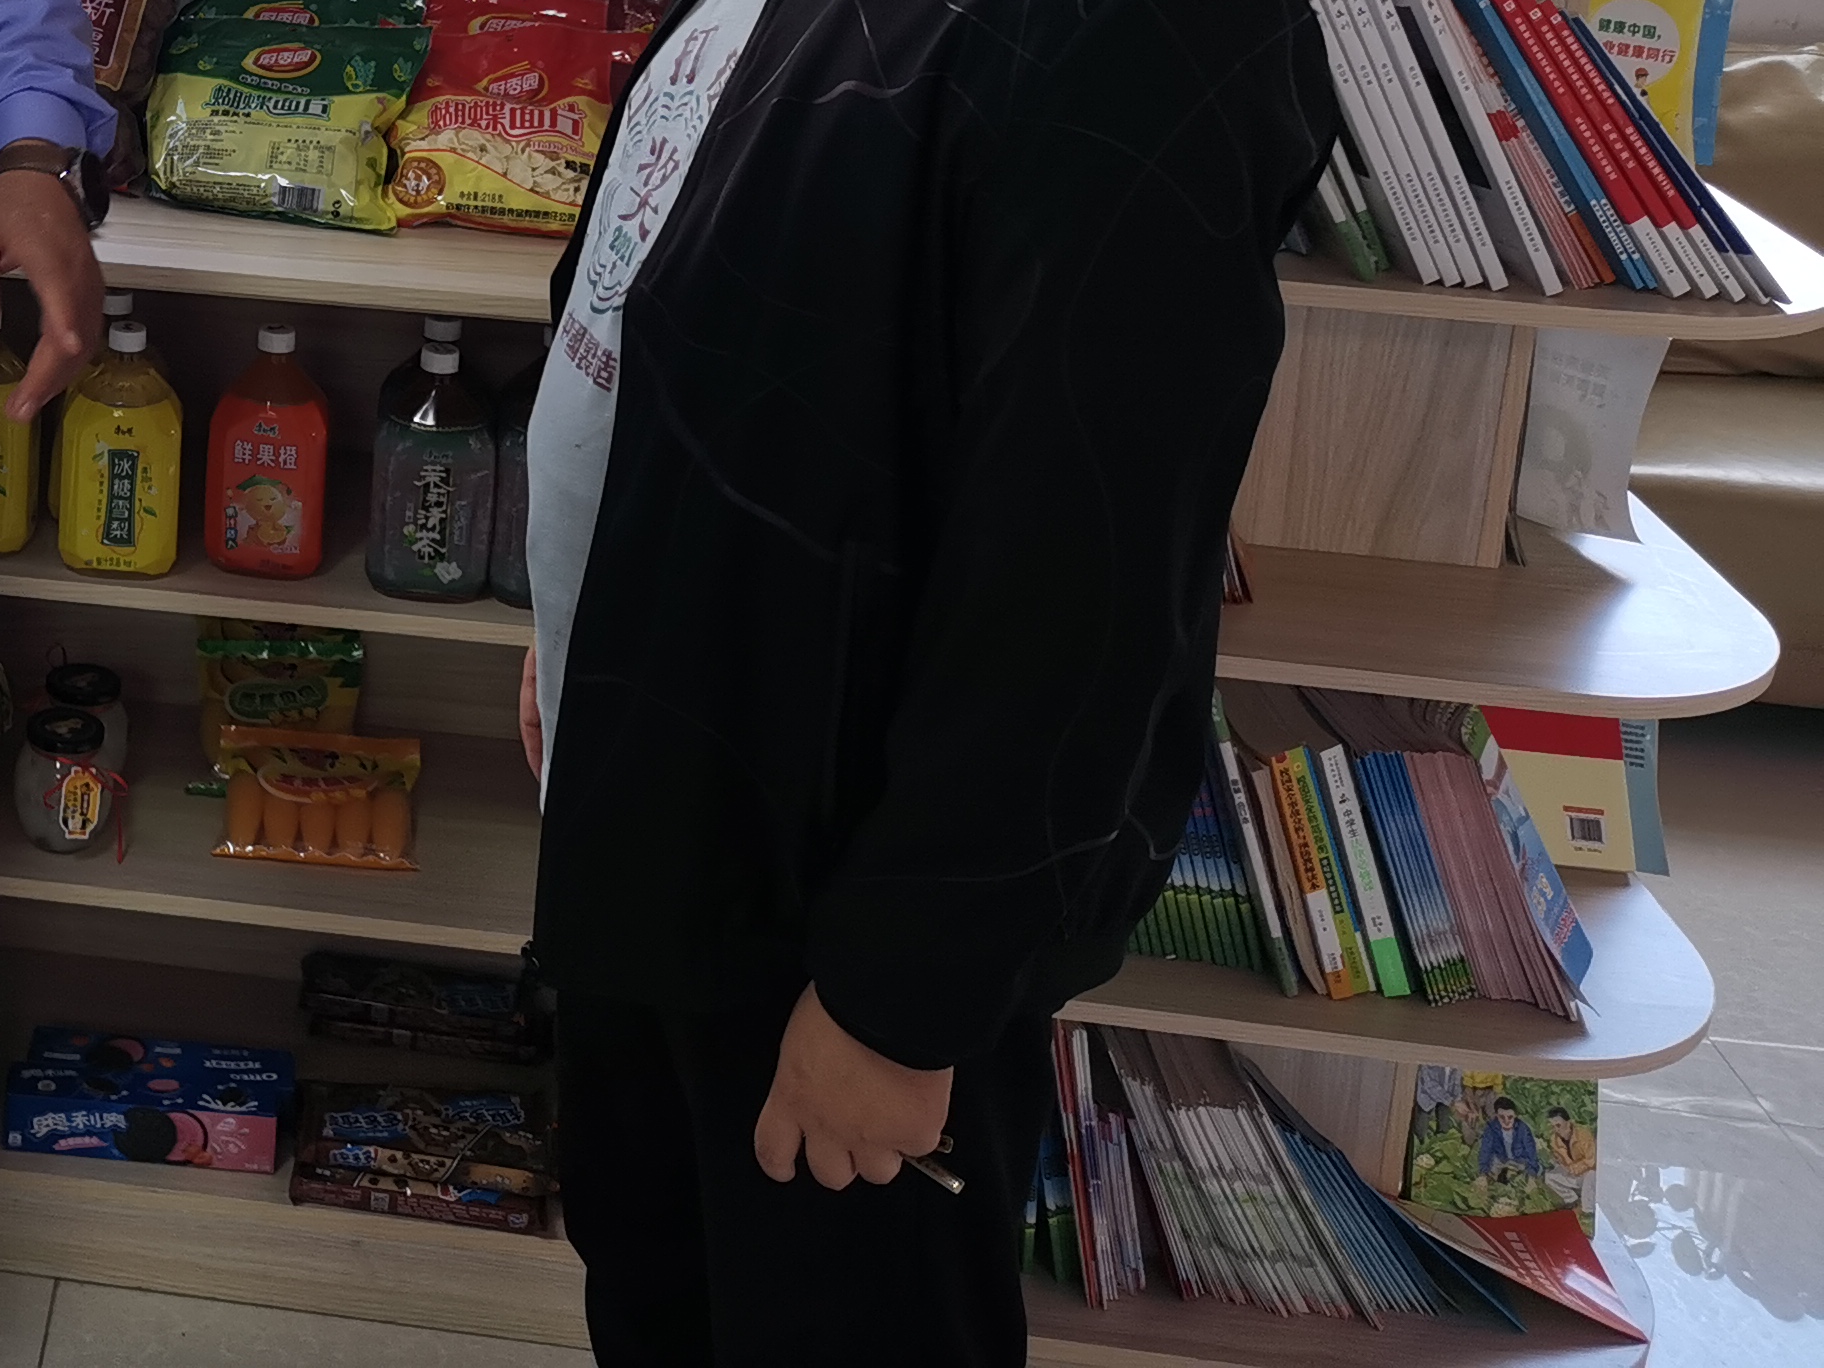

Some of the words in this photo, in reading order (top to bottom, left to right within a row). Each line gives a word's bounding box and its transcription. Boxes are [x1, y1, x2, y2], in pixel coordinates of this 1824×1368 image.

[429, 97, 586, 146] 蝴蝶面片
[233, 440, 298, 470] 鲜果橙
[108, 457, 133, 540] 冰糖雪梨
[413, 465, 456, 563] 茉莉清茶
